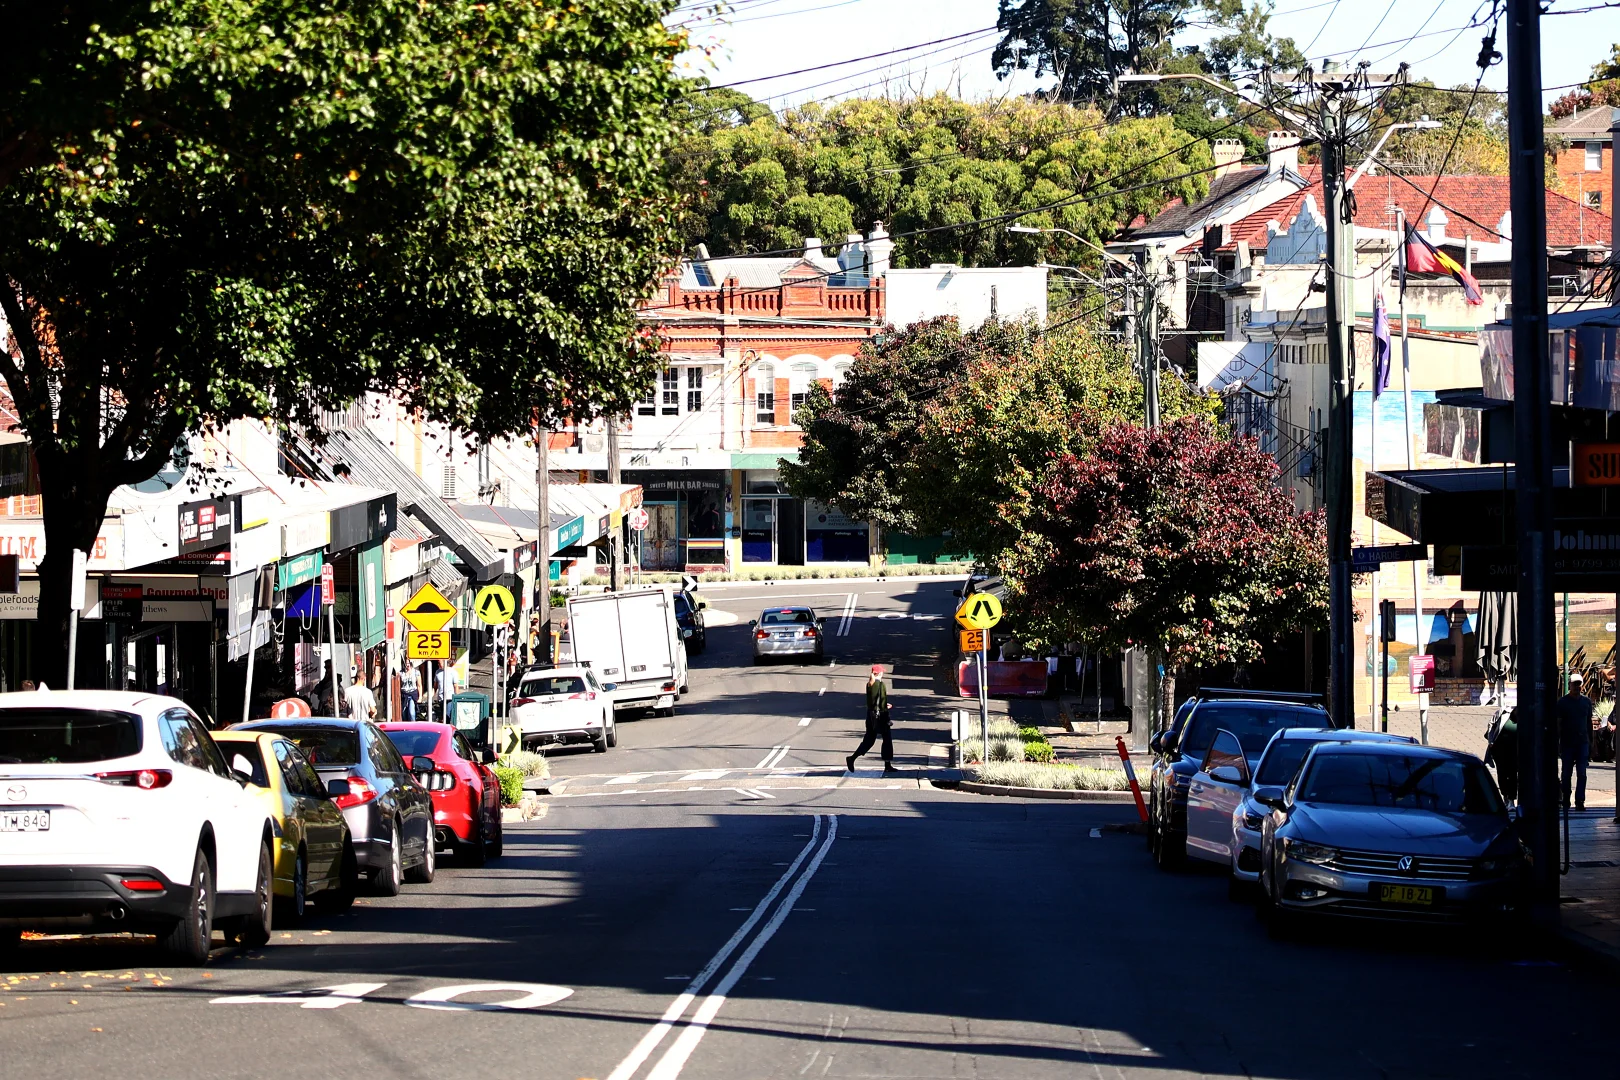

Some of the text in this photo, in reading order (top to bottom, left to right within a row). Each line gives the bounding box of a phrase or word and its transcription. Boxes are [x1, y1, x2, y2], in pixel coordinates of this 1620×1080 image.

[667, 481, 686, 490] MILK
[687, 481, 702, 490] BAR
[1368, 551, 1400, 561] HARDIE
[1572, 559, 1603, 569] 9799
[201, 588, 229, 600] Chic
[417, 634, 442, 649] 25
[966, 632, 984, 644] 25
[23, 814, 47, 828] 84G
[1382, 886, 1431, 902] DF 18 ZL
